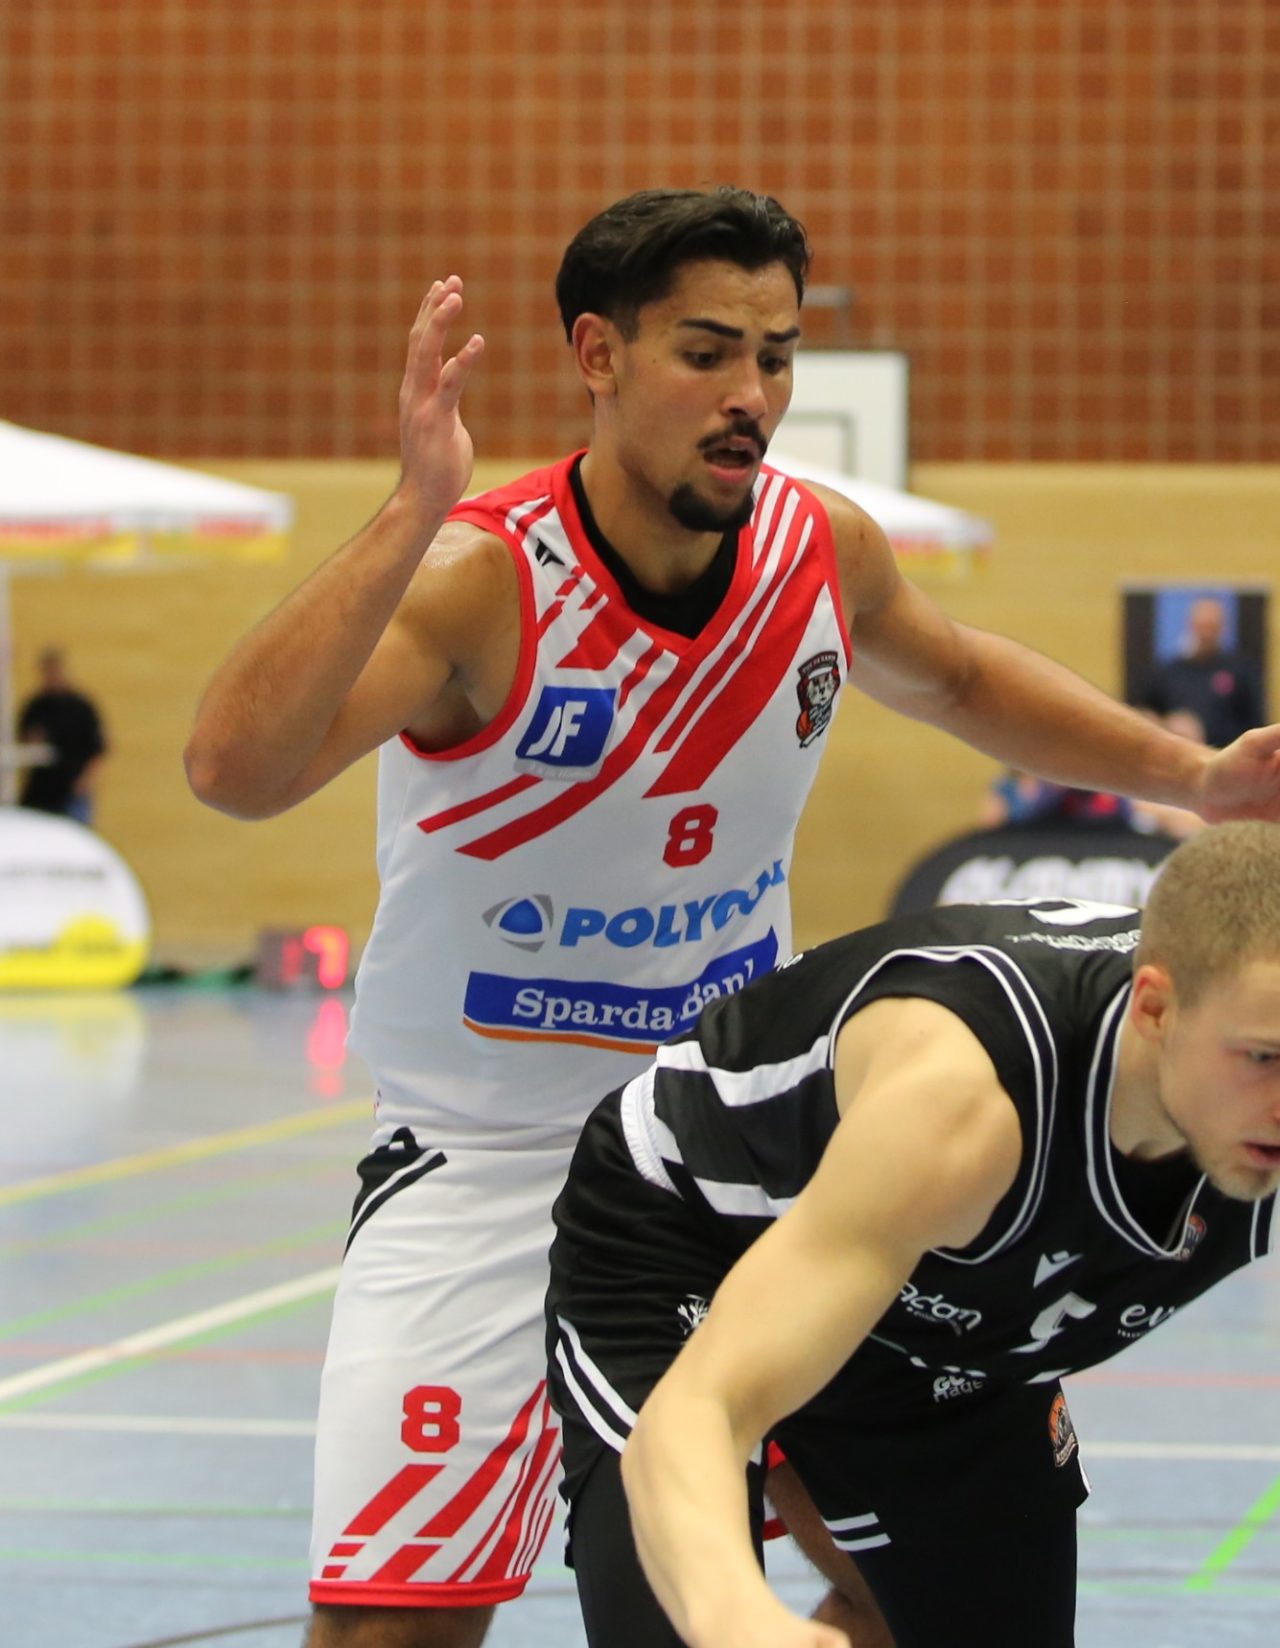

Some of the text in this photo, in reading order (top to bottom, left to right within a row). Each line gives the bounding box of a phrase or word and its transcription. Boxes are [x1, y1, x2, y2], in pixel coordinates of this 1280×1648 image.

[525, 700, 588, 758] JF
[662, 803, 719, 868] 8
[401, 1385, 462, 1453] 8
